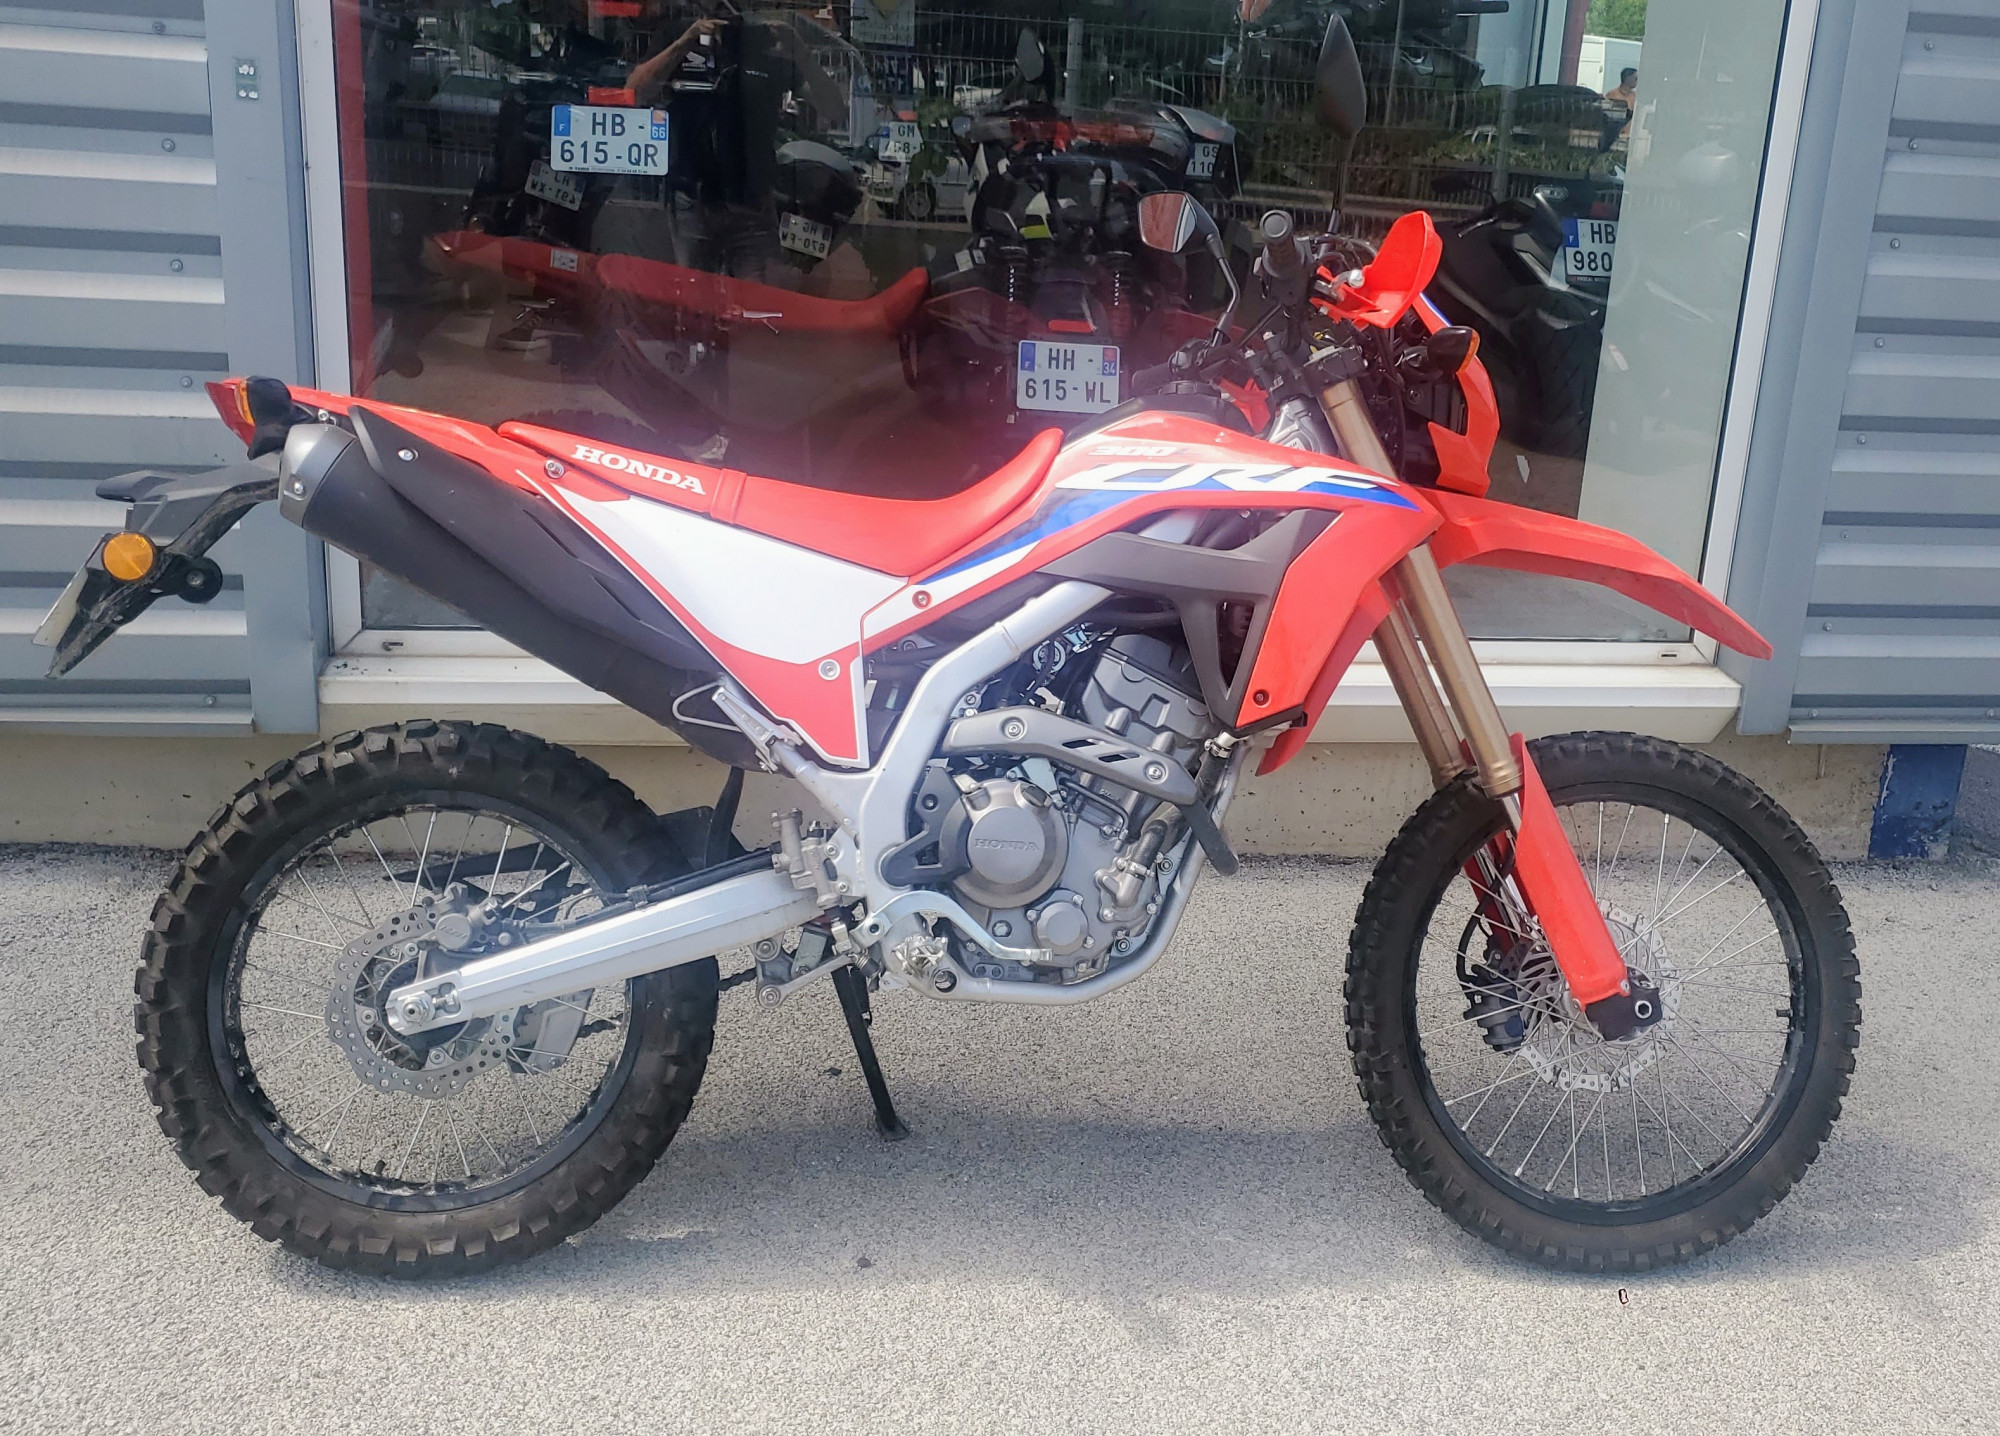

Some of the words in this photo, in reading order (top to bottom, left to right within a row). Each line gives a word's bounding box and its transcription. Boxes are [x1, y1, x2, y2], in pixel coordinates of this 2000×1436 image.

[559, 123, 566, 132] F
[591, 112, 626, 137] HB
[651, 126, 666, 139] 66
[560, 139, 659, 168] 615-QR
[1569, 235, 1575, 244] F
[1590, 222, 1617, 244] HB
[1573, 250, 1613, 272] 980
[1024, 361, 1031, 369] F
[1047, 347, 1076, 371] HH
[1103, 361, 1116, 375] 34
[1025, 377, 1111, 404] 615-WL
[569, 443, 707, 496] HONDA
[1054, 462, 1402, 492] CRF
[973, 838, 1040, 852] HONDA
